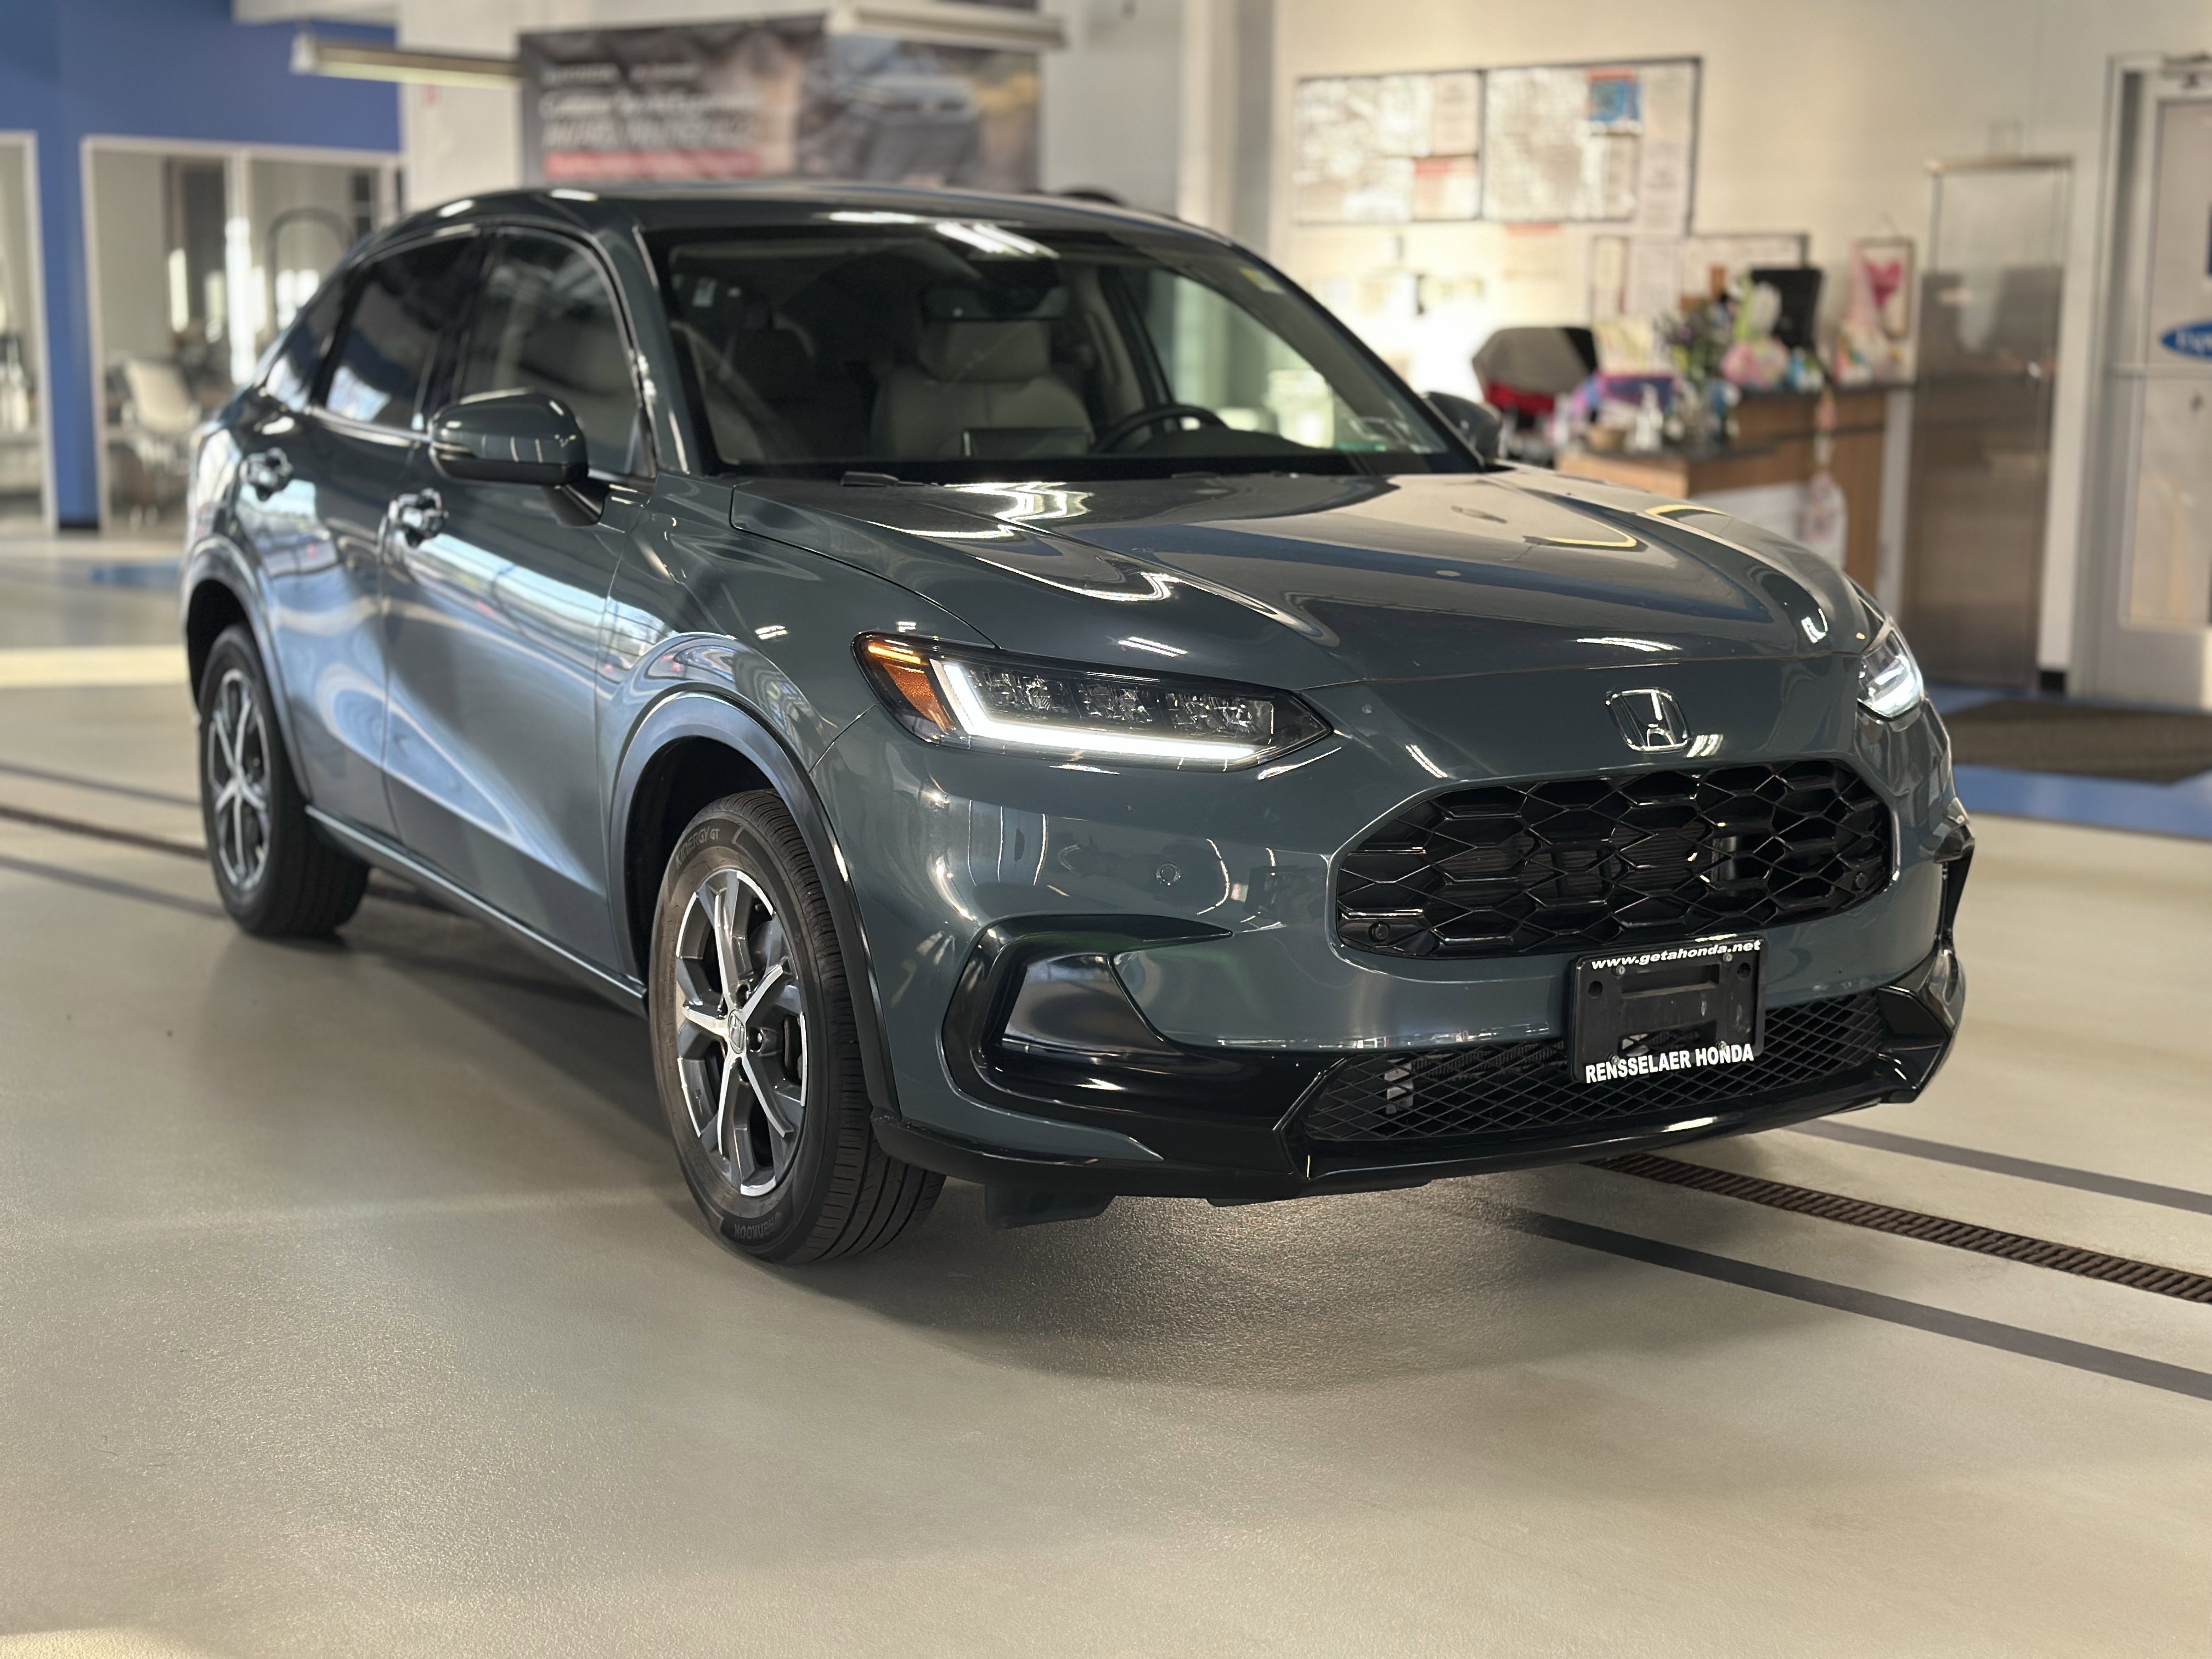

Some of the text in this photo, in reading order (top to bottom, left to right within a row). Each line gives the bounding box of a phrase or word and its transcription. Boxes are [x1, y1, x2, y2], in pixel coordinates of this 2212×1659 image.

[710, 828, 720, 840] GT
[1592, 940, 1761, 969] www.getahonda.net
[1585, 1043, 1754, 1084] RENSSELAER HONDA
